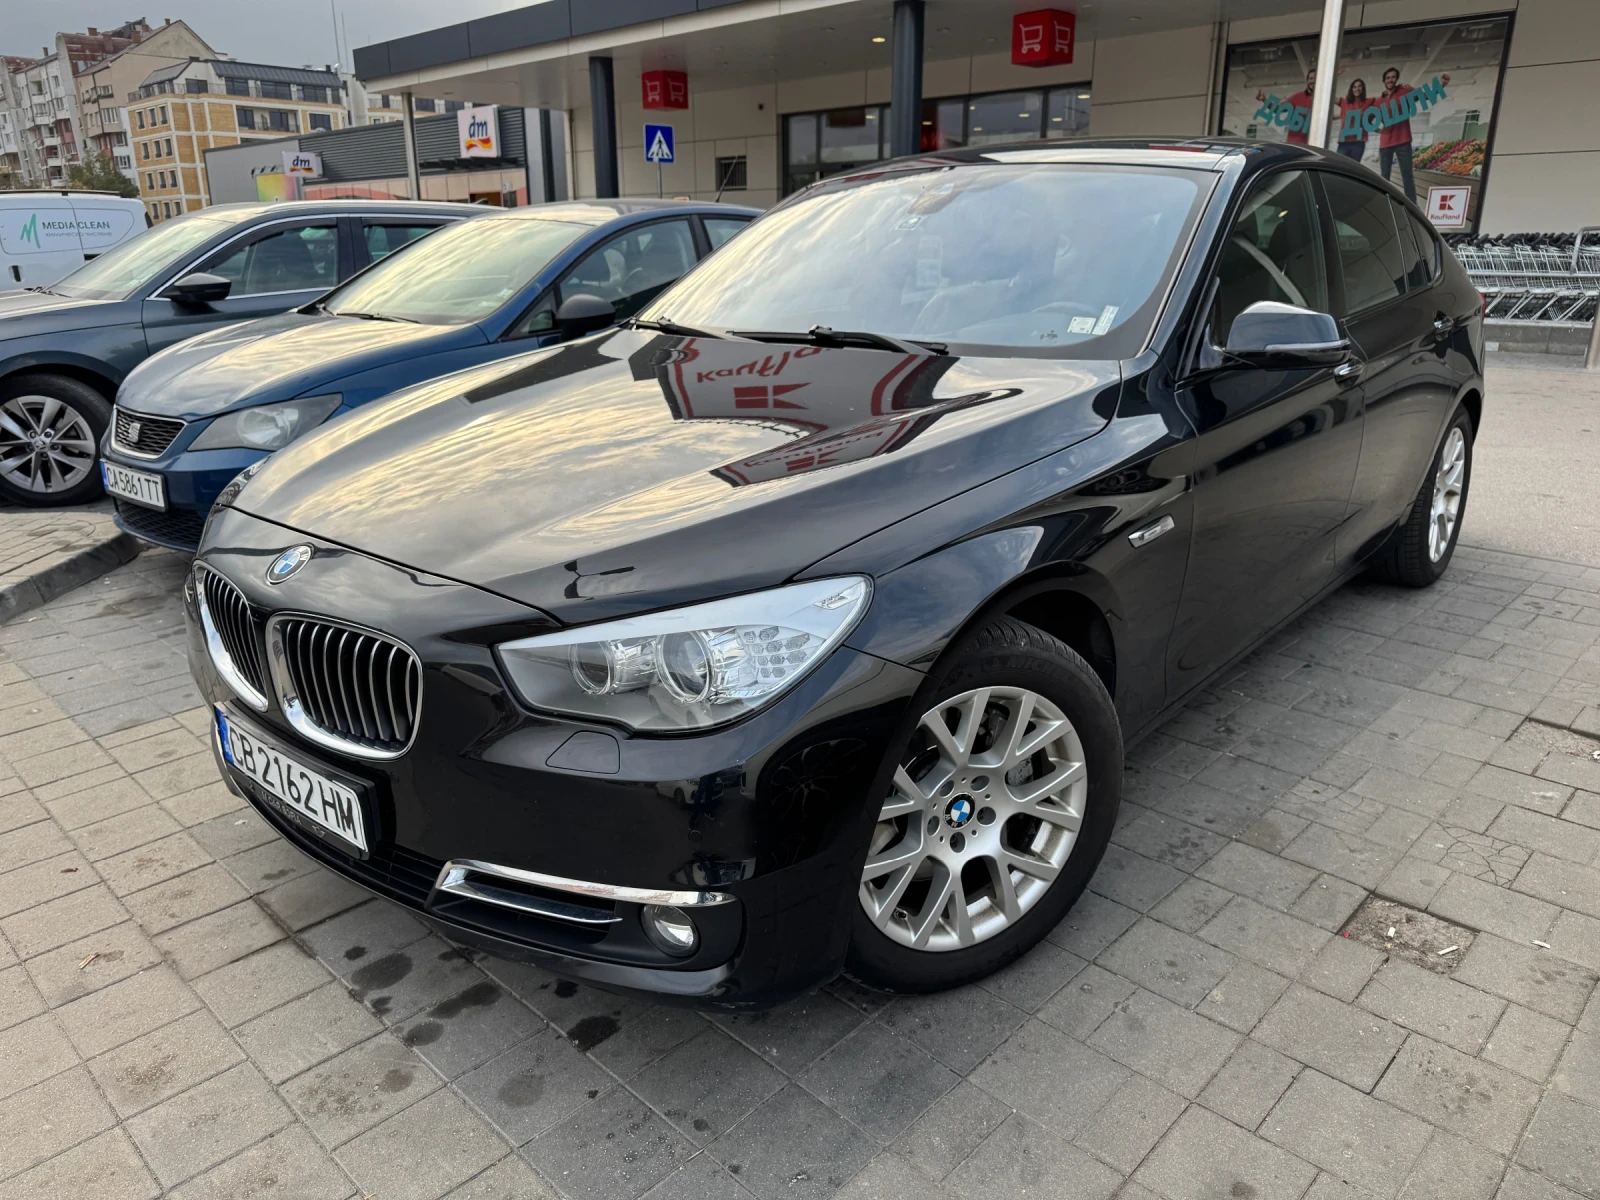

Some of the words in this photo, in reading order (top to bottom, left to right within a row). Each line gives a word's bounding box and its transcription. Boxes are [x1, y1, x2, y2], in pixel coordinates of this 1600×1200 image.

[1253, 93, 1312, 134] ДОБ
[1340, 76, 1447, 142] ДОШЛИ
[469, 115, 488, 138] dm
[292, 155, 310, 168] dm
[42, 221, 76, 230] MEDIA
[77, 221, 110, 230] CLEAN
